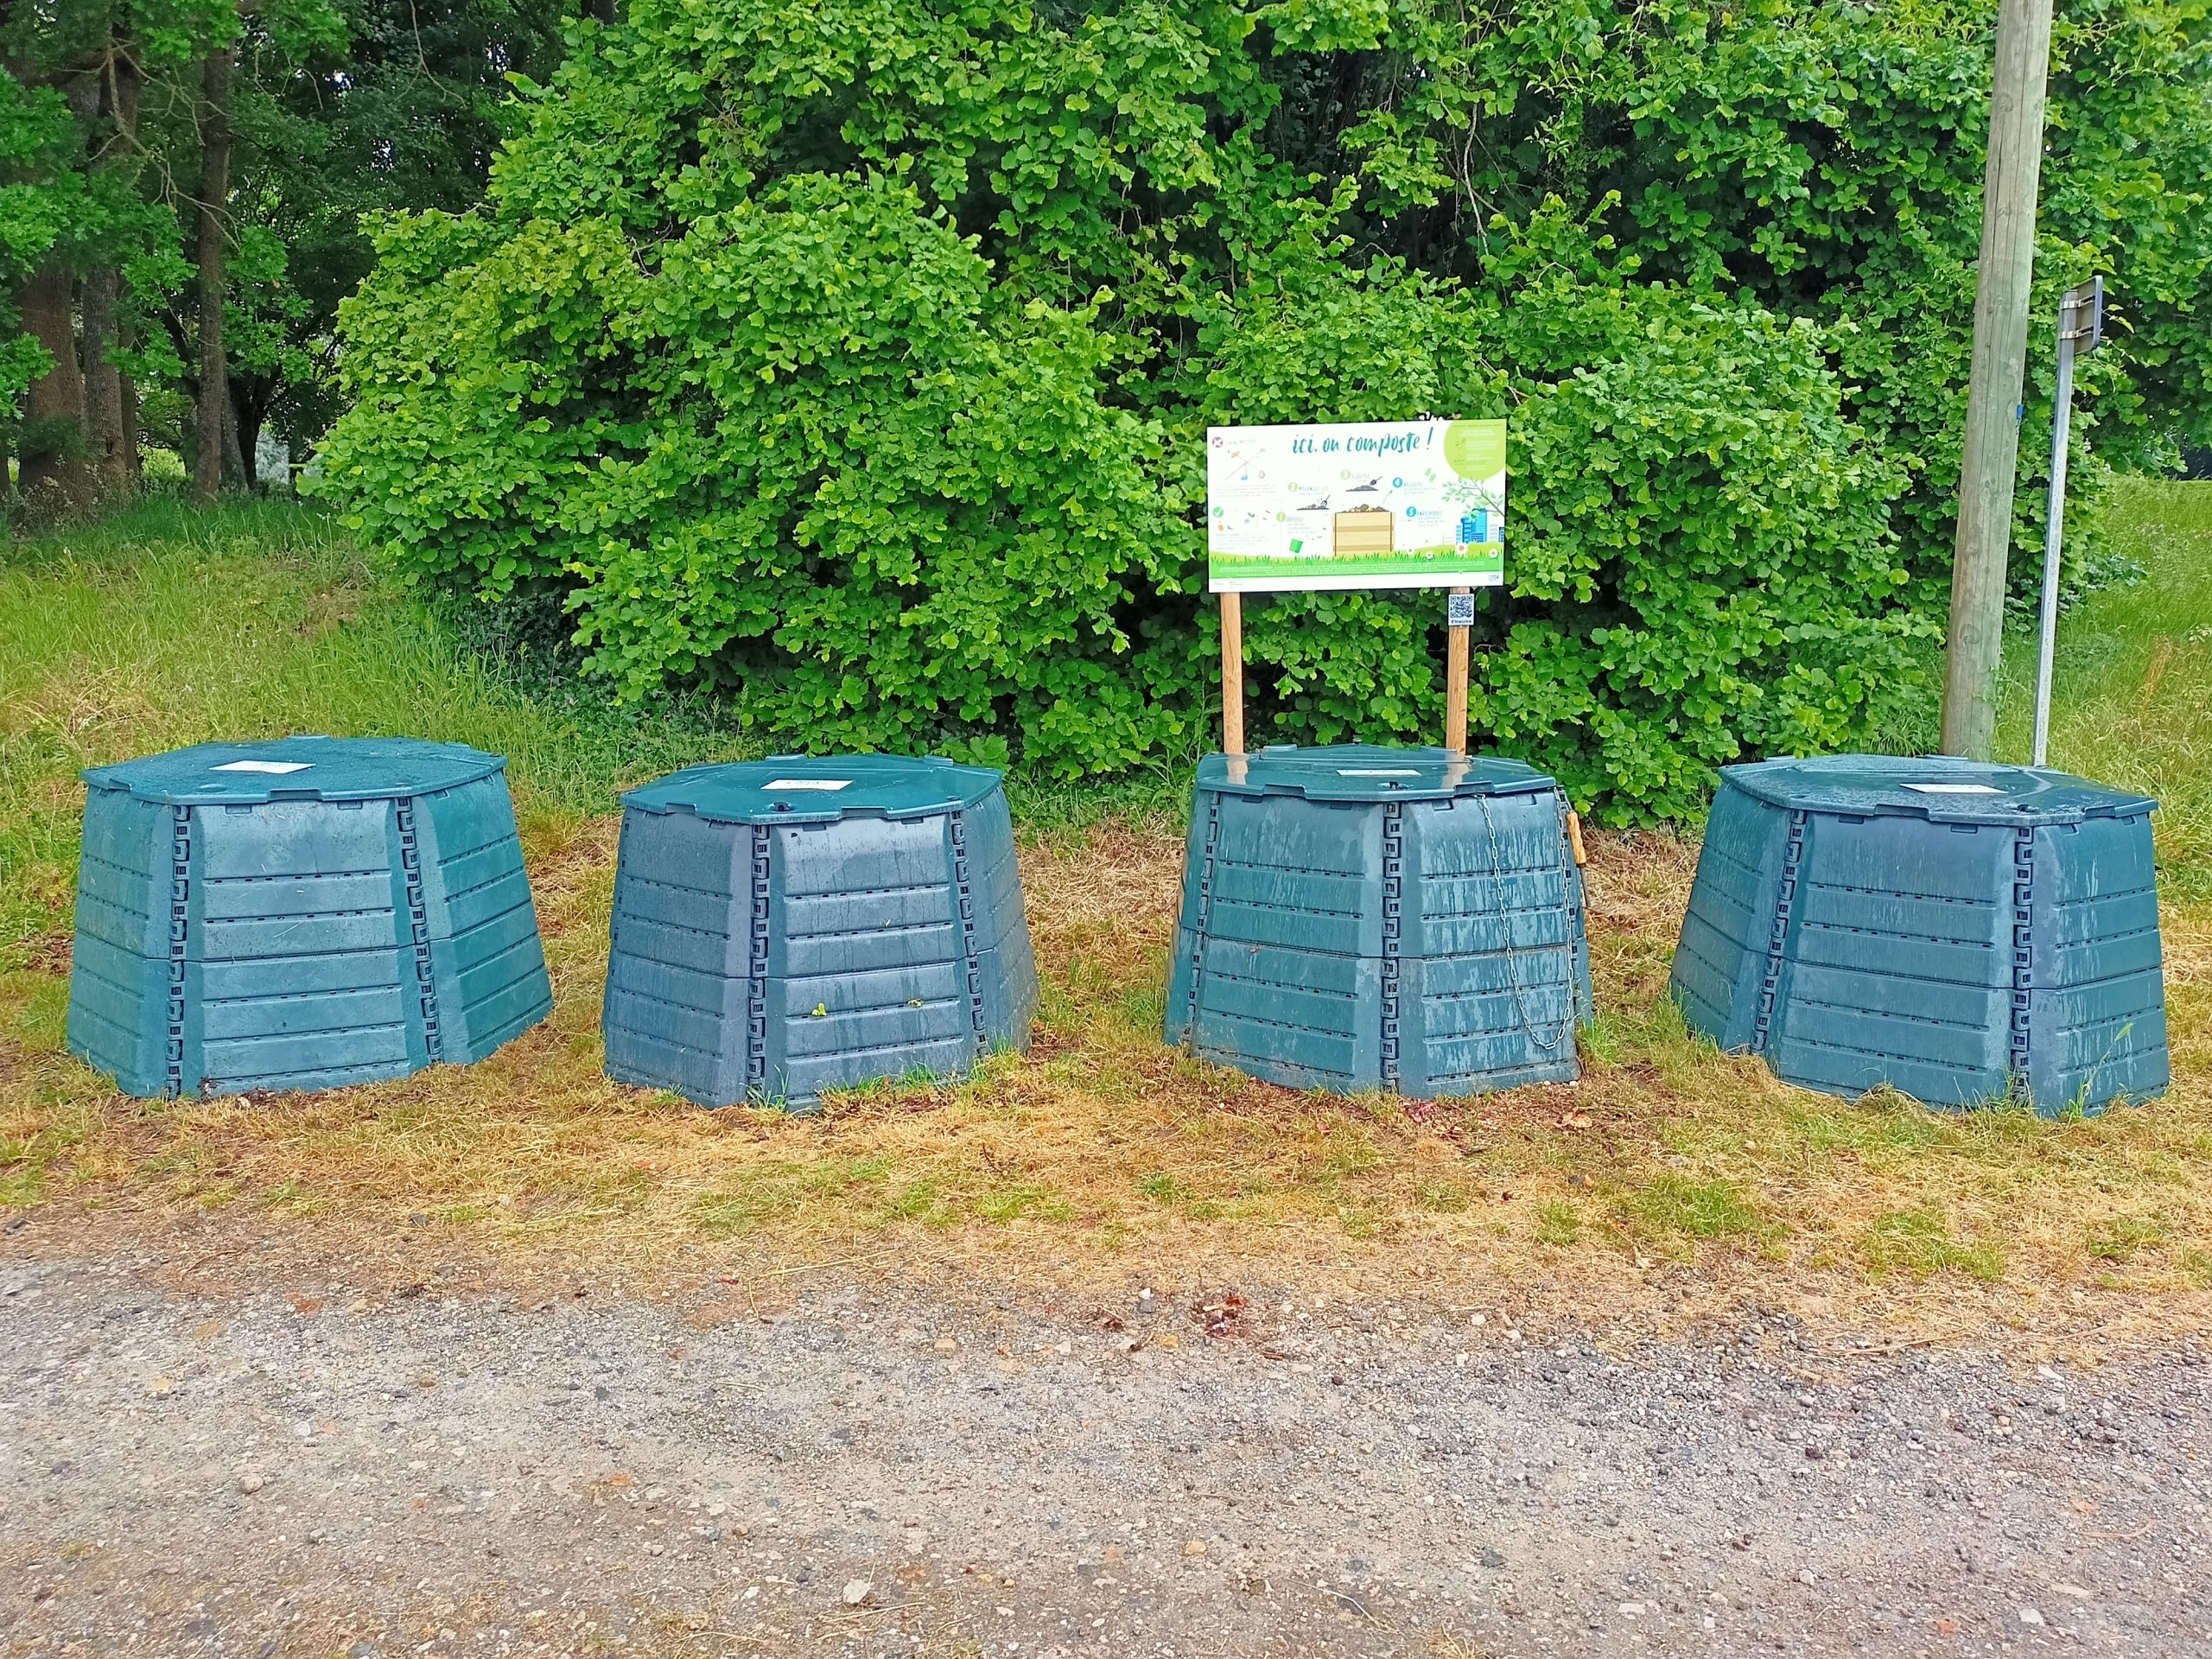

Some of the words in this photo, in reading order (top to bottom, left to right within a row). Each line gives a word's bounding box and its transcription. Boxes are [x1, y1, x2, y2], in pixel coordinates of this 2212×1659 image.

[1322, 437, 1340, 453] on
[1346, 431, 1421, 458] composte
[1426, 426, 1433, 450] !
